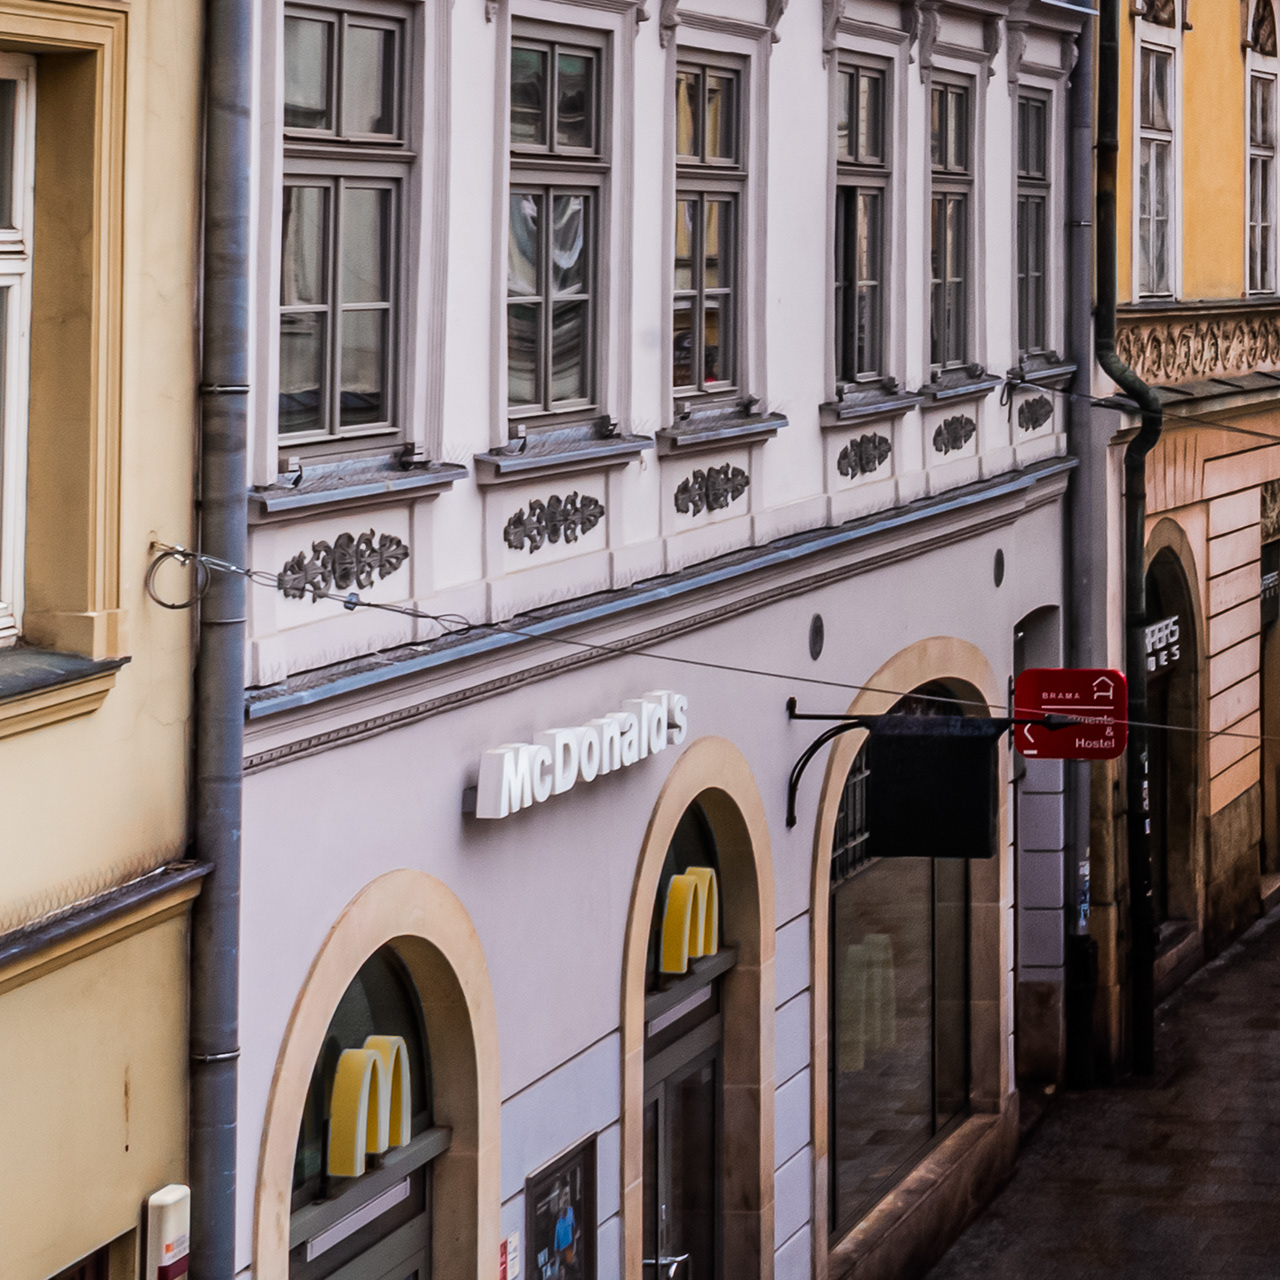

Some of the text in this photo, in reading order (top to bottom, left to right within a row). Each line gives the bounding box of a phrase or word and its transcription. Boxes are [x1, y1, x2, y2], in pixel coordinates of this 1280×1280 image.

[1042, 692, 1081, 700] BRAMA
[1105, 726, 1114, 737] &
[1075, 738, 1115, 748] Hostel
[487, 688, 689, 819] McDonald's
